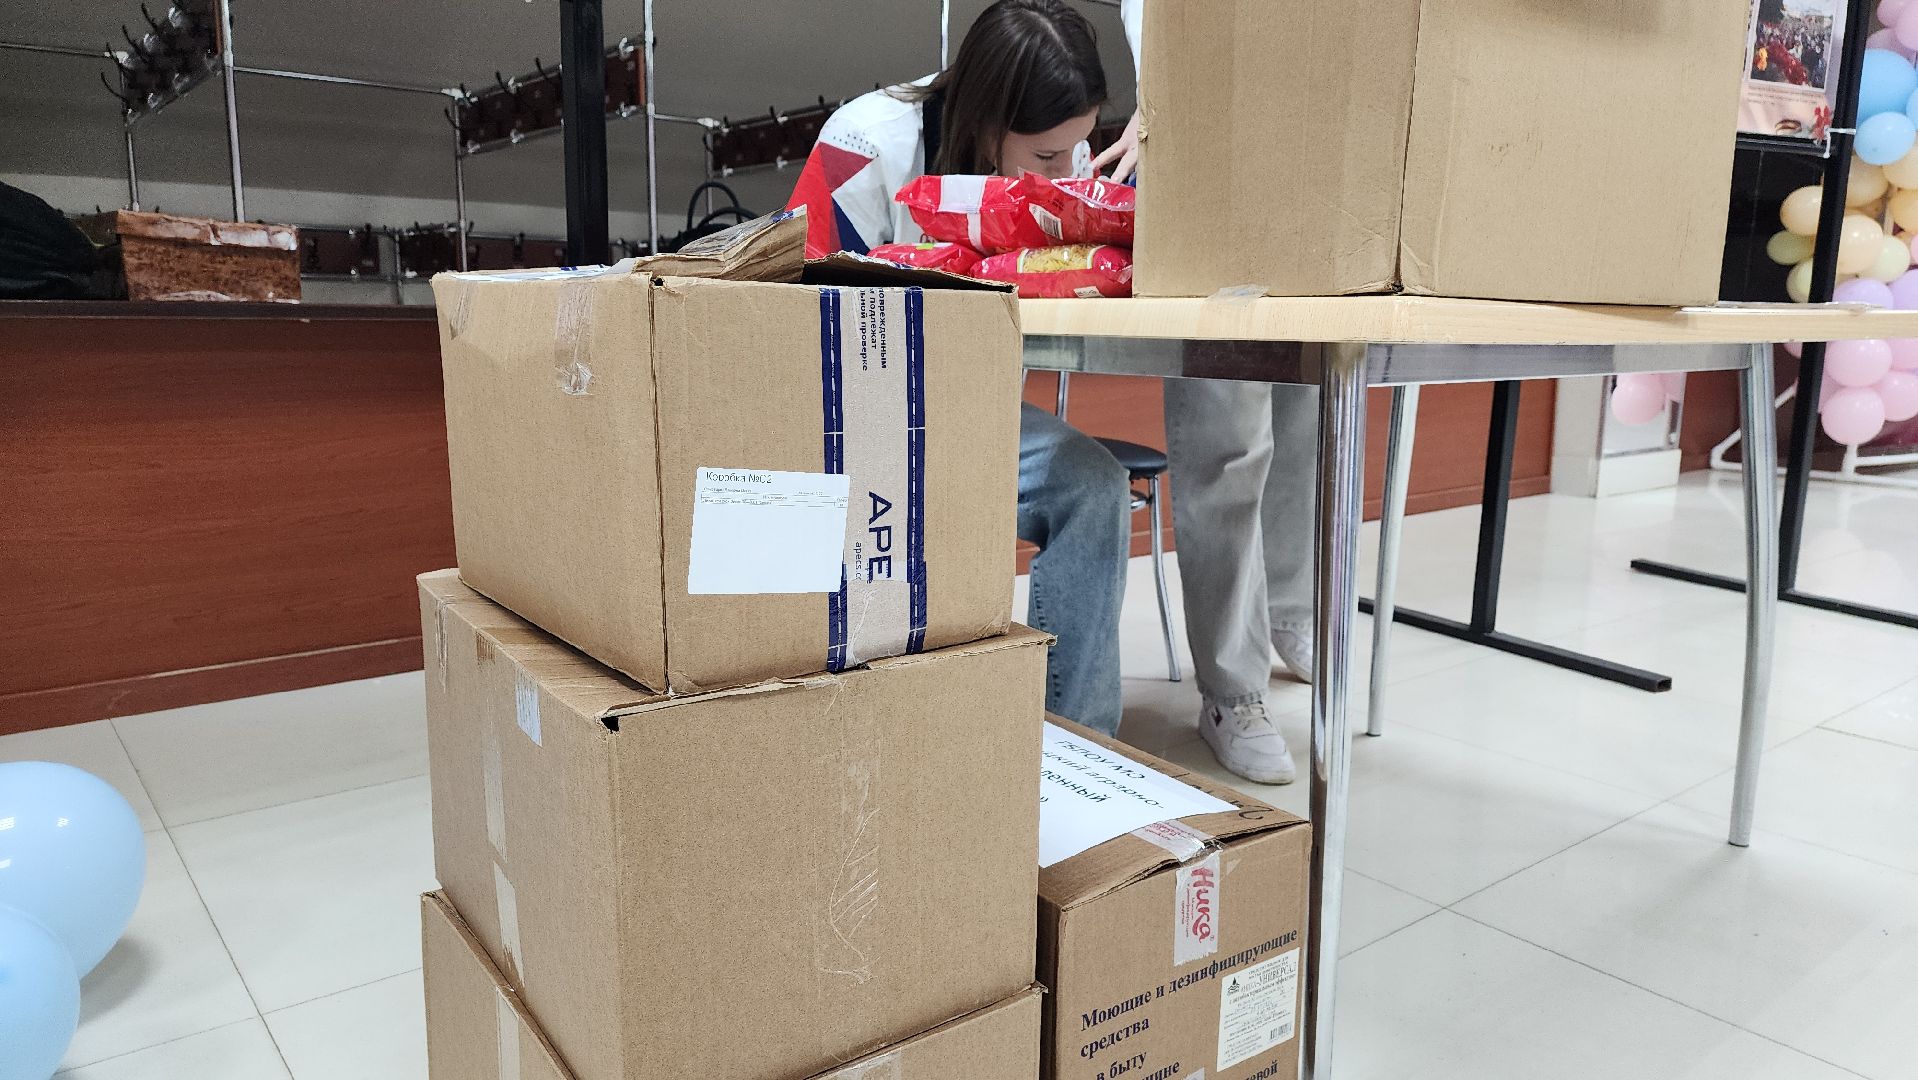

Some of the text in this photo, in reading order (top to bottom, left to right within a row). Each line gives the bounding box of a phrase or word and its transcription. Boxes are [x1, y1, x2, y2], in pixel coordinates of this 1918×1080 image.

[869, 297, 878, 350] подлежат
[860, 321, 868, 372] проверке
[706, 471, 747, 483] Коробка
[1041, 769, 1112, 803] ленный
[1191, 867, 1215, 943] Ника
[1081, 989, 1152, 1031] Моющие
[1155, 985, 1166, 1001] и
[1168, 928, 1298, 993] дезинфицирующие
[1081, 1018, 1150, 1058] средства
[1109, 1052, 1147, 1079] быту
[1246, 1059, 1278, 1080] евой
